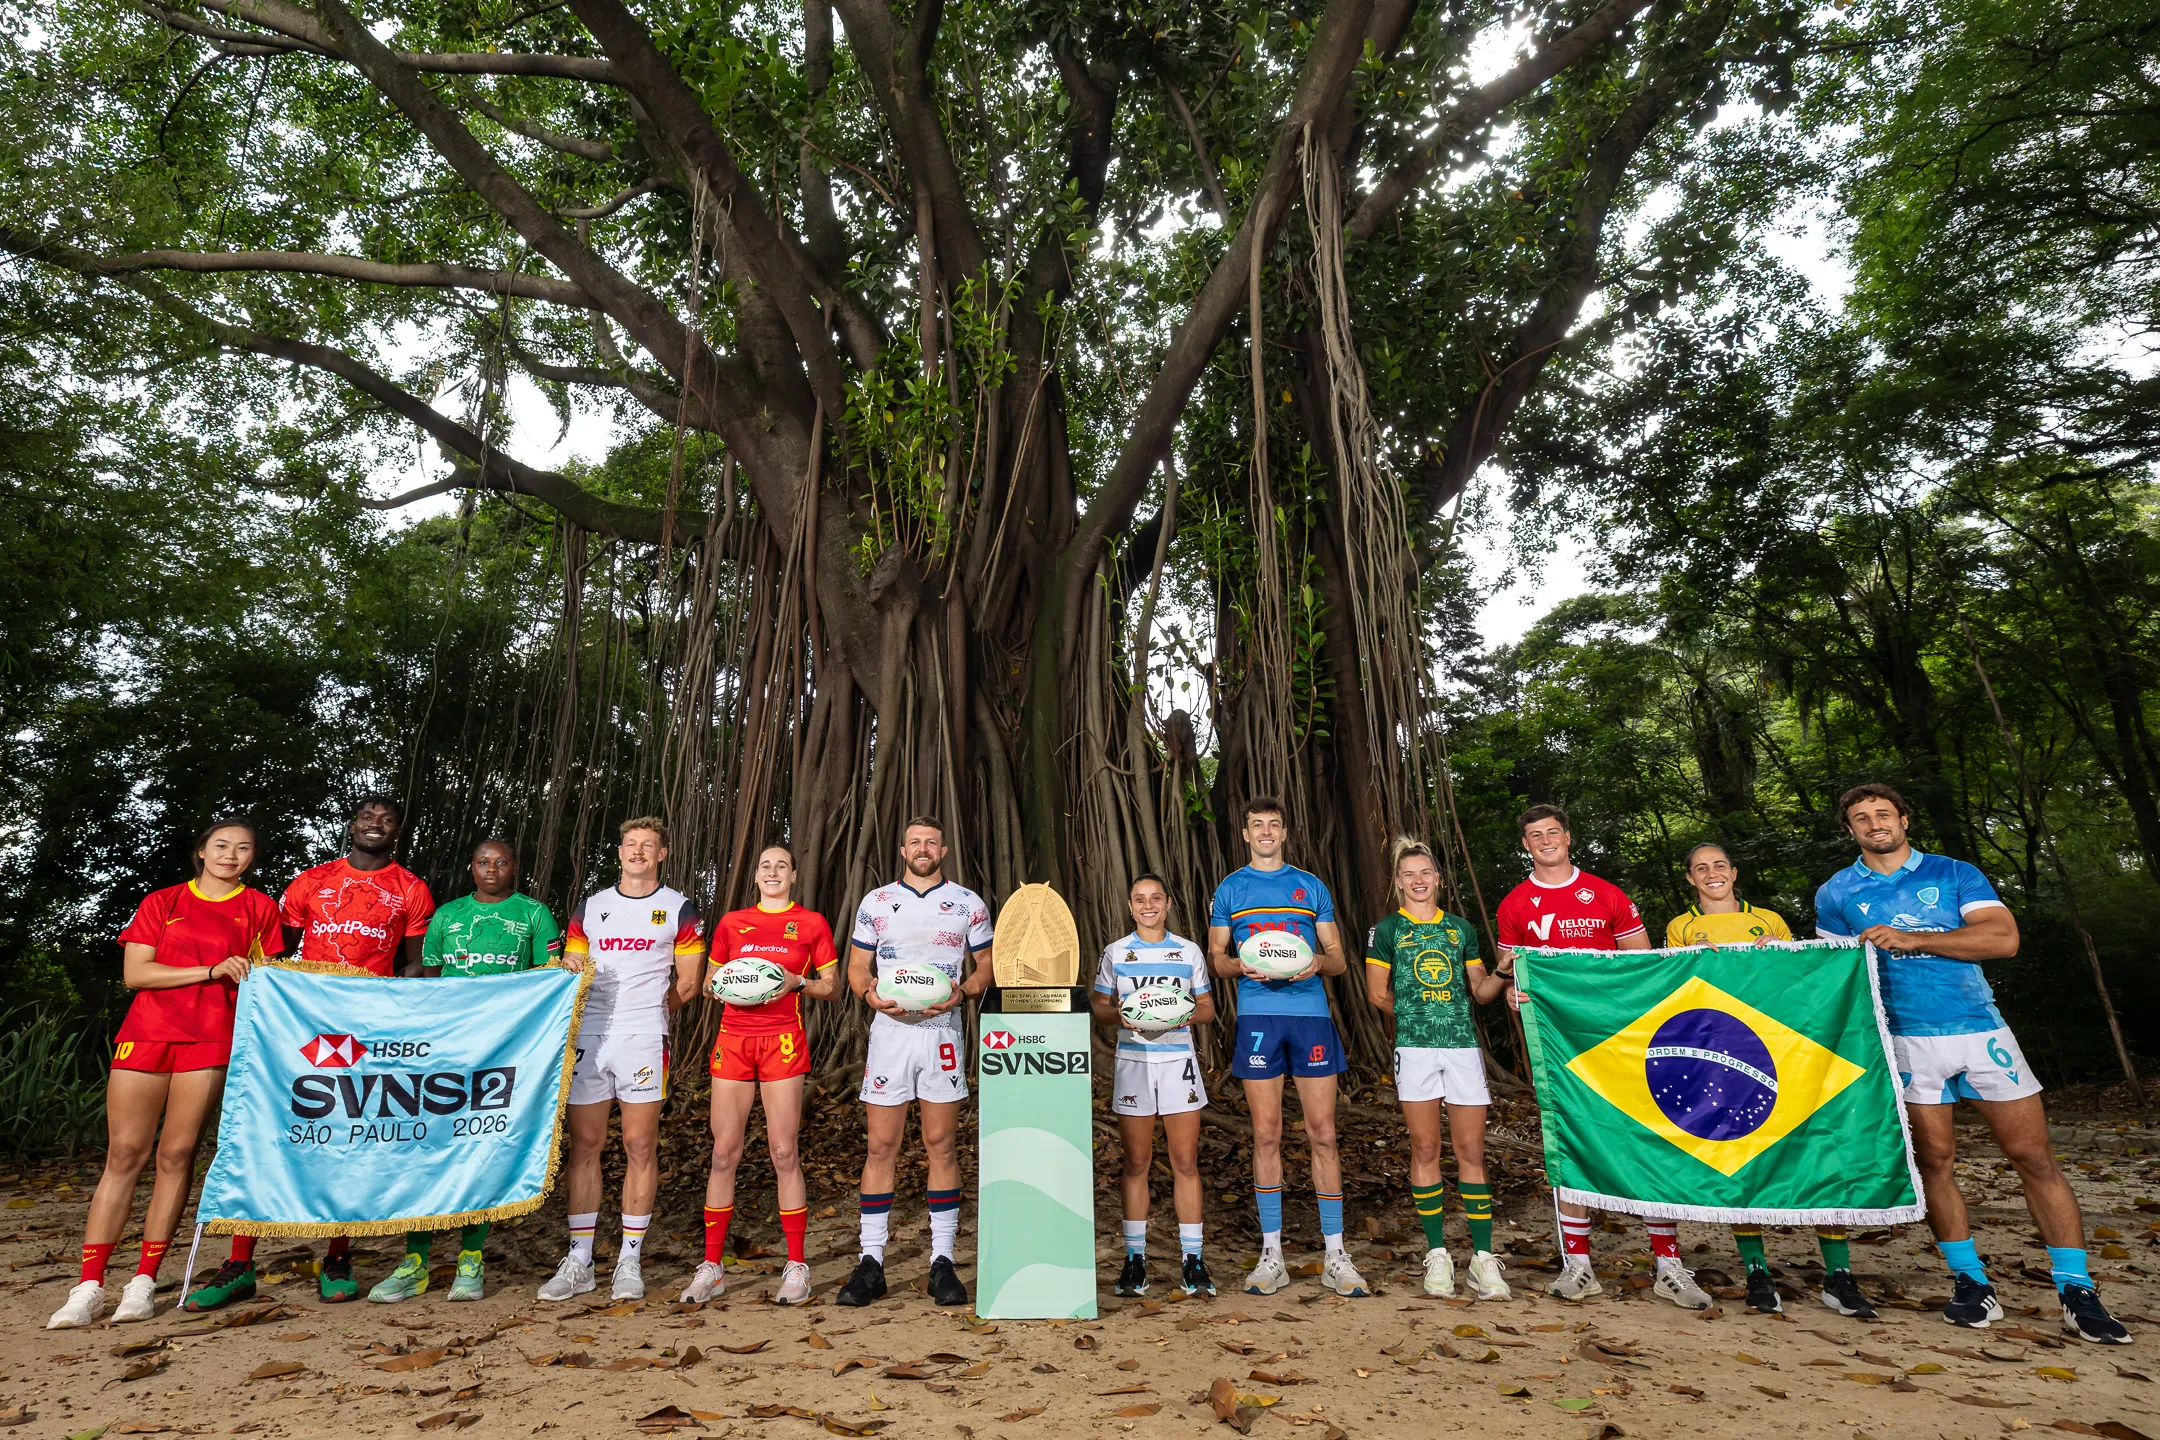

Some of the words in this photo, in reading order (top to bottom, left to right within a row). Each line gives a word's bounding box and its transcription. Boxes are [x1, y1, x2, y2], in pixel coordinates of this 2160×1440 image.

[312, 920, 387, 939] SportPesa
[1557, 918, 1606, 929] VELOCITY
[1559, 928, 1594, 938] TRADE
[598, 937, 657, 951] unzer
[754, 945, 788, 954] Iberdrola
[1422, 990, 1451, 1001] FNB
[779, 1033, 795, 1055] 8
[1018, 1035, 1046, 1044] HSBC
[1251, 1031, 1264, 1052] 7
[114, 1041, 135, 1061] 10
[373, 1042, 431, 1058] HSBC
[939, 1042, 957, 1072] 9
[1987, 1037, 2013, 1069] 6
[1182, 1058, 1196, 1085] 4
[1648, 1048, 1686, 1057] ORDEM
[1703, 1051, 1775, 1088] PROGRESSO
[289, 1120, 332, 1144] SÃO
[349, 1121, 427, 1144] PAULO
[453, 1114, 508, 1137] 2026
